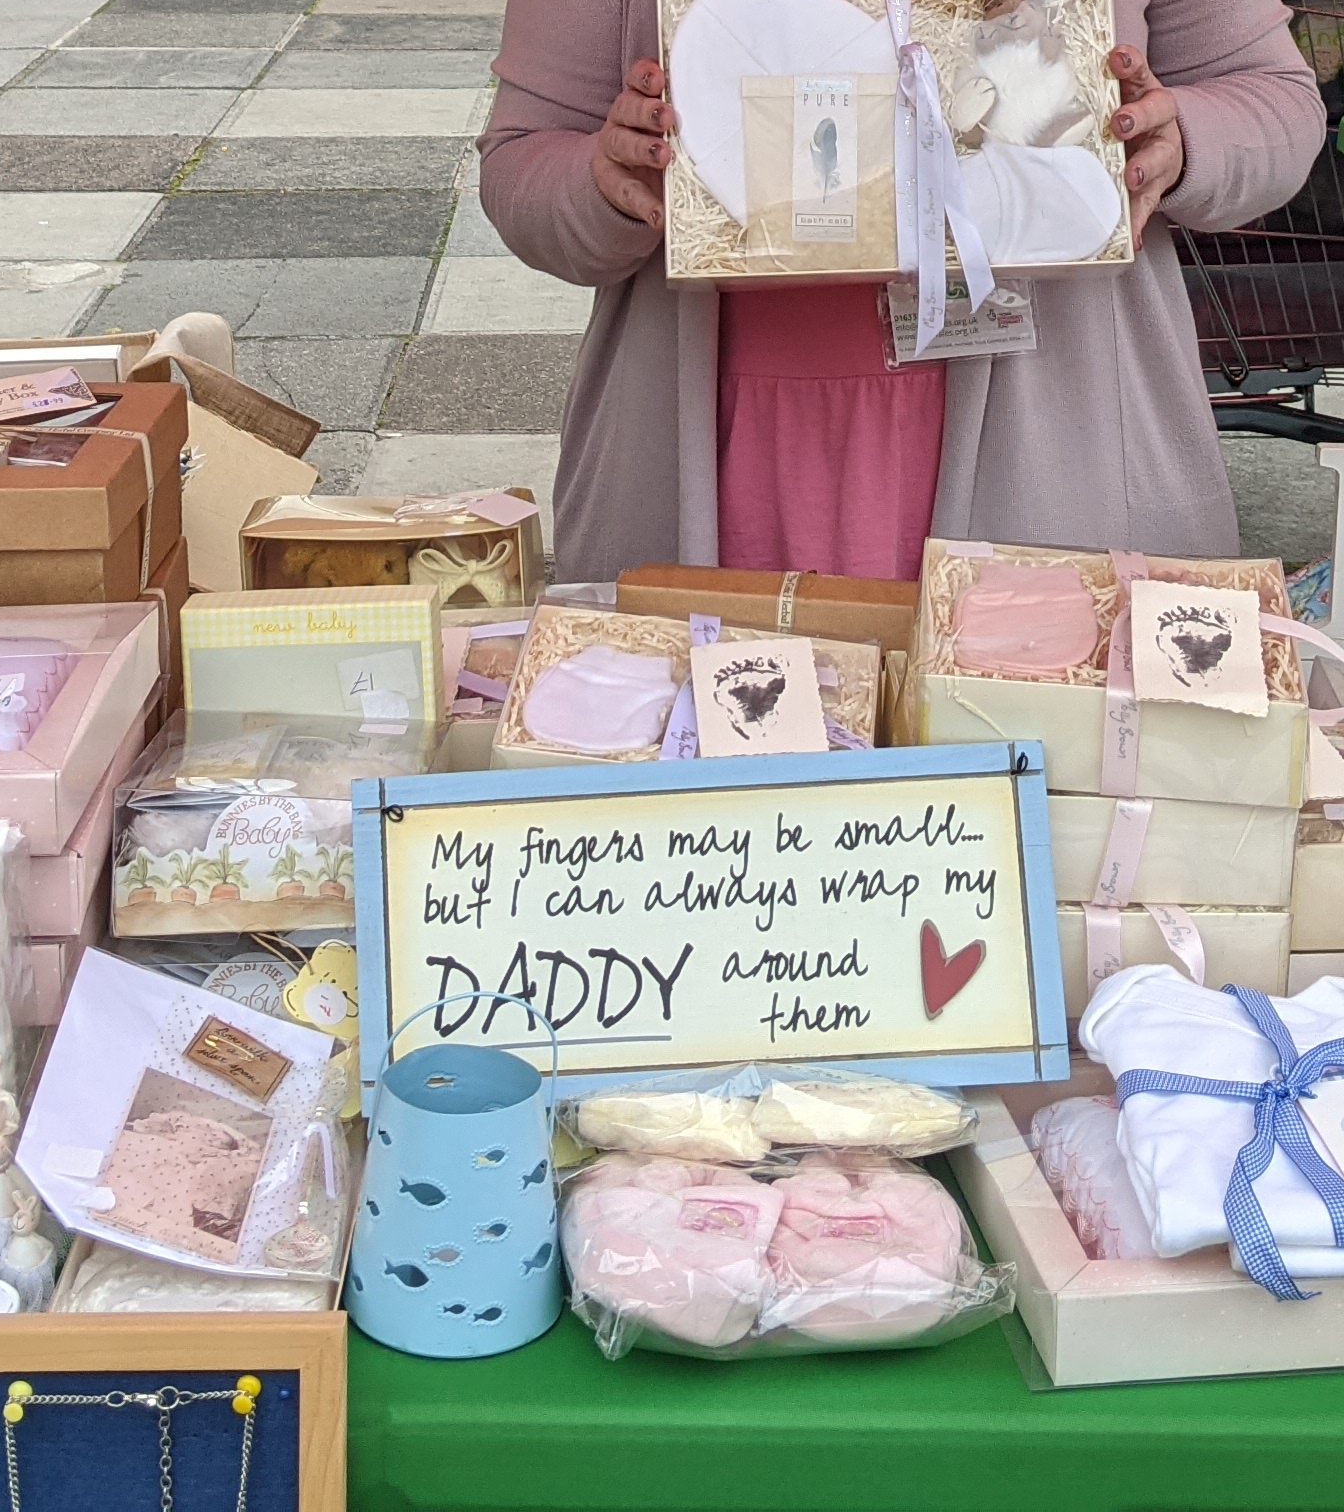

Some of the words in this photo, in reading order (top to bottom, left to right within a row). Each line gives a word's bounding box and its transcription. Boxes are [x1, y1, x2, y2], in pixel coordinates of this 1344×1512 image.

[803, 94, 848, 106] PURE
[9, 388, 40, 402] Box
[21, 383, 36, 391] &
[253, 621, 297, 634] new
[306, 611, 358, 638] baby
[1118, 726, 1133, 759] Brown
[215, 796, 257, 839] BUNNIES
[257, 795, 273, 806] BY
[273, 796, 296, 815] THE
[287, 810, 305, 839] BAY
[230, 817, 292, 859] Baby
[432, 832, 494, 890] My
[519, 827, 645, 881] fingers
[668, 827, 751, 877] may
[777, 812, 813, 854] be
[423, 879, 492, 929] but
[510, 879, 521, 917] I
[545, 883, 625, 916] can
[645, 869, 797, 931] always
[821, 869, 920, 917] wrap
[943, 865, 997, 919] my
[259, 963, 284, 982] THE
[427, 942, 694, 1037] DADDY
[722, 938, 869, 984] around
[760, 992, 870, 1045] them
